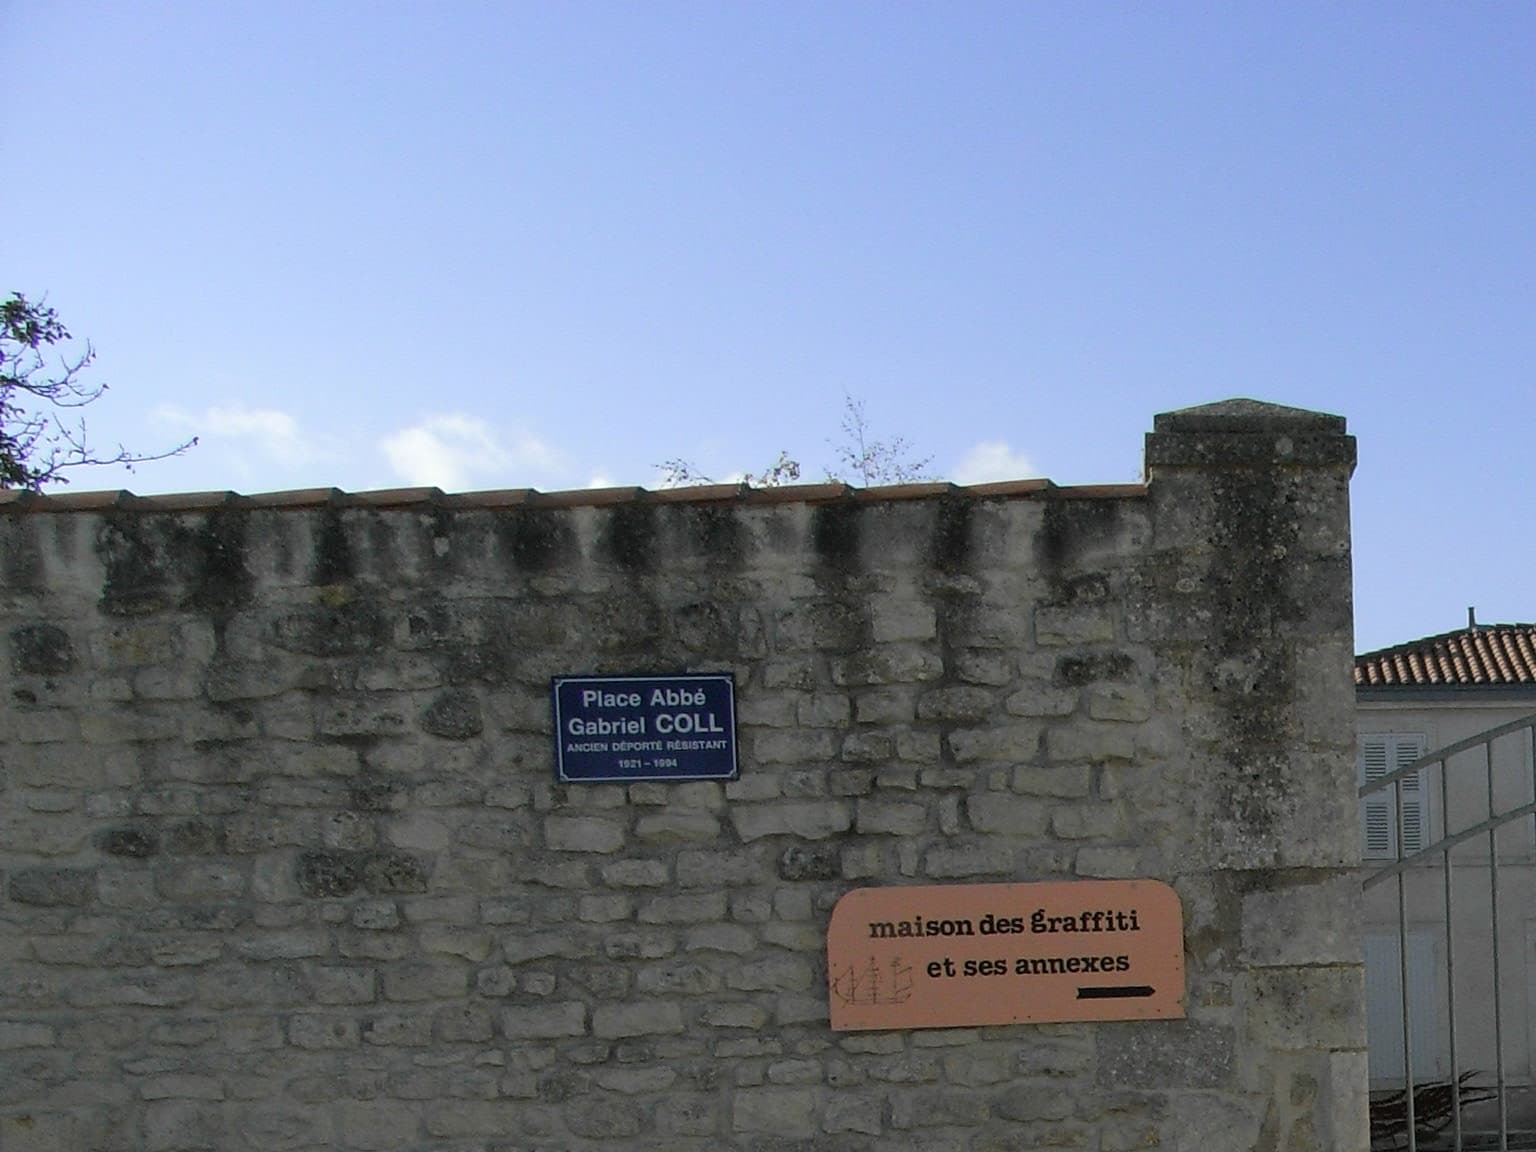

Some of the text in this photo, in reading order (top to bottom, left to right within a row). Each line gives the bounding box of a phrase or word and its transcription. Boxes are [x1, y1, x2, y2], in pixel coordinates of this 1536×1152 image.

[583, 687, 706, 708] Place Abbé
[568, 713, 724, 736] Gabriel COLL
[567, 742, 608, 753] ANCIEN
[667, 739, 728, 751] RÉSISTANT
[869, 908, 1140, 939] maison des graffiti
[926, 953, 1130, 978] et ses annexes
